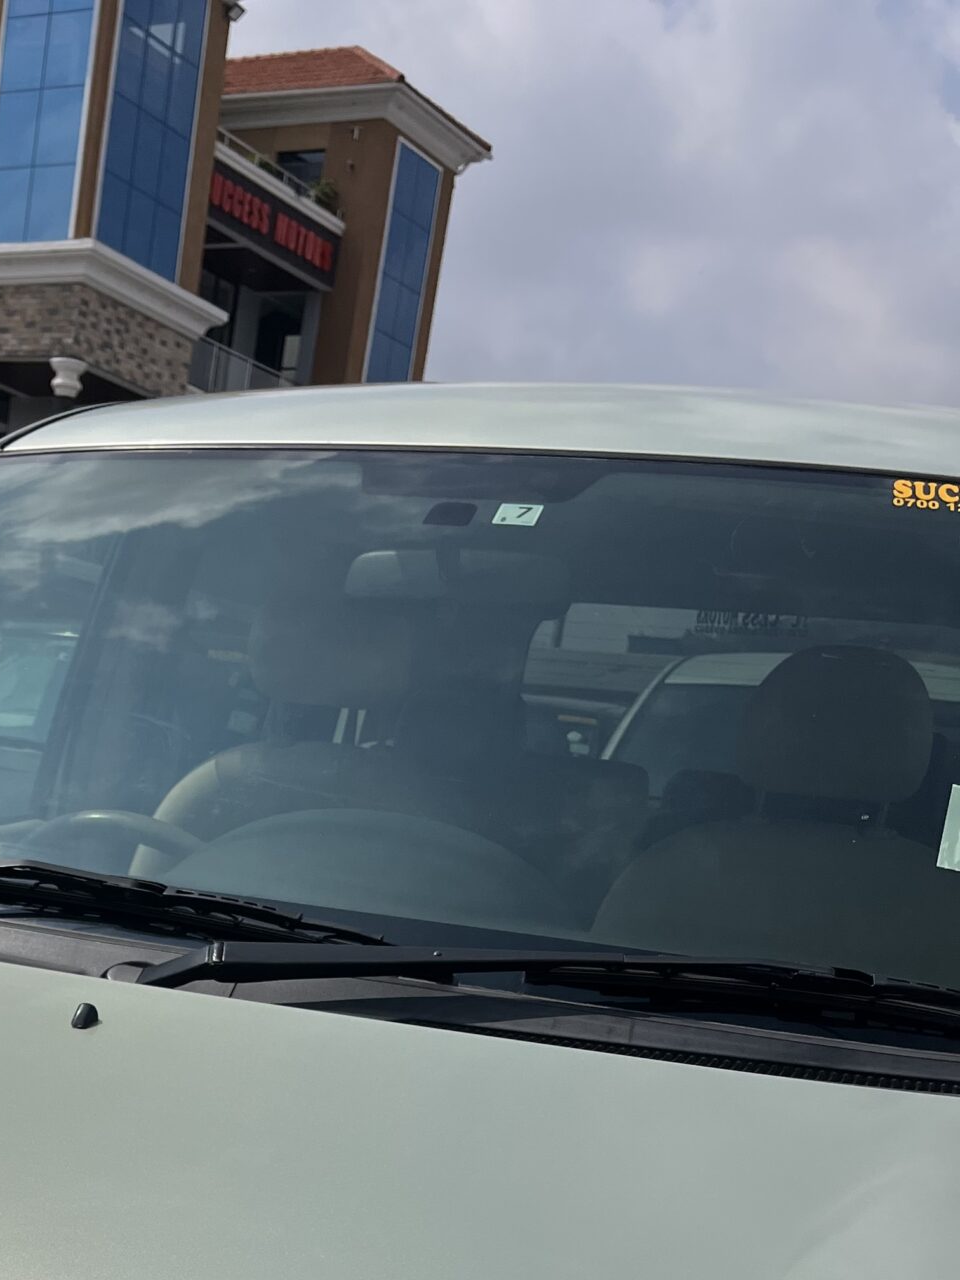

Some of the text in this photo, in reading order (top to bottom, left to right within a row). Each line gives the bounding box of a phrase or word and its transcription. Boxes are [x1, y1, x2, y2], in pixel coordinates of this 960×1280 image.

[211, 173, 270, 235] UCCESS
[892, 479, 960, 503] SUC
[516, 506, 534, 519] 7
[892, 497, 939, 510] 0700
